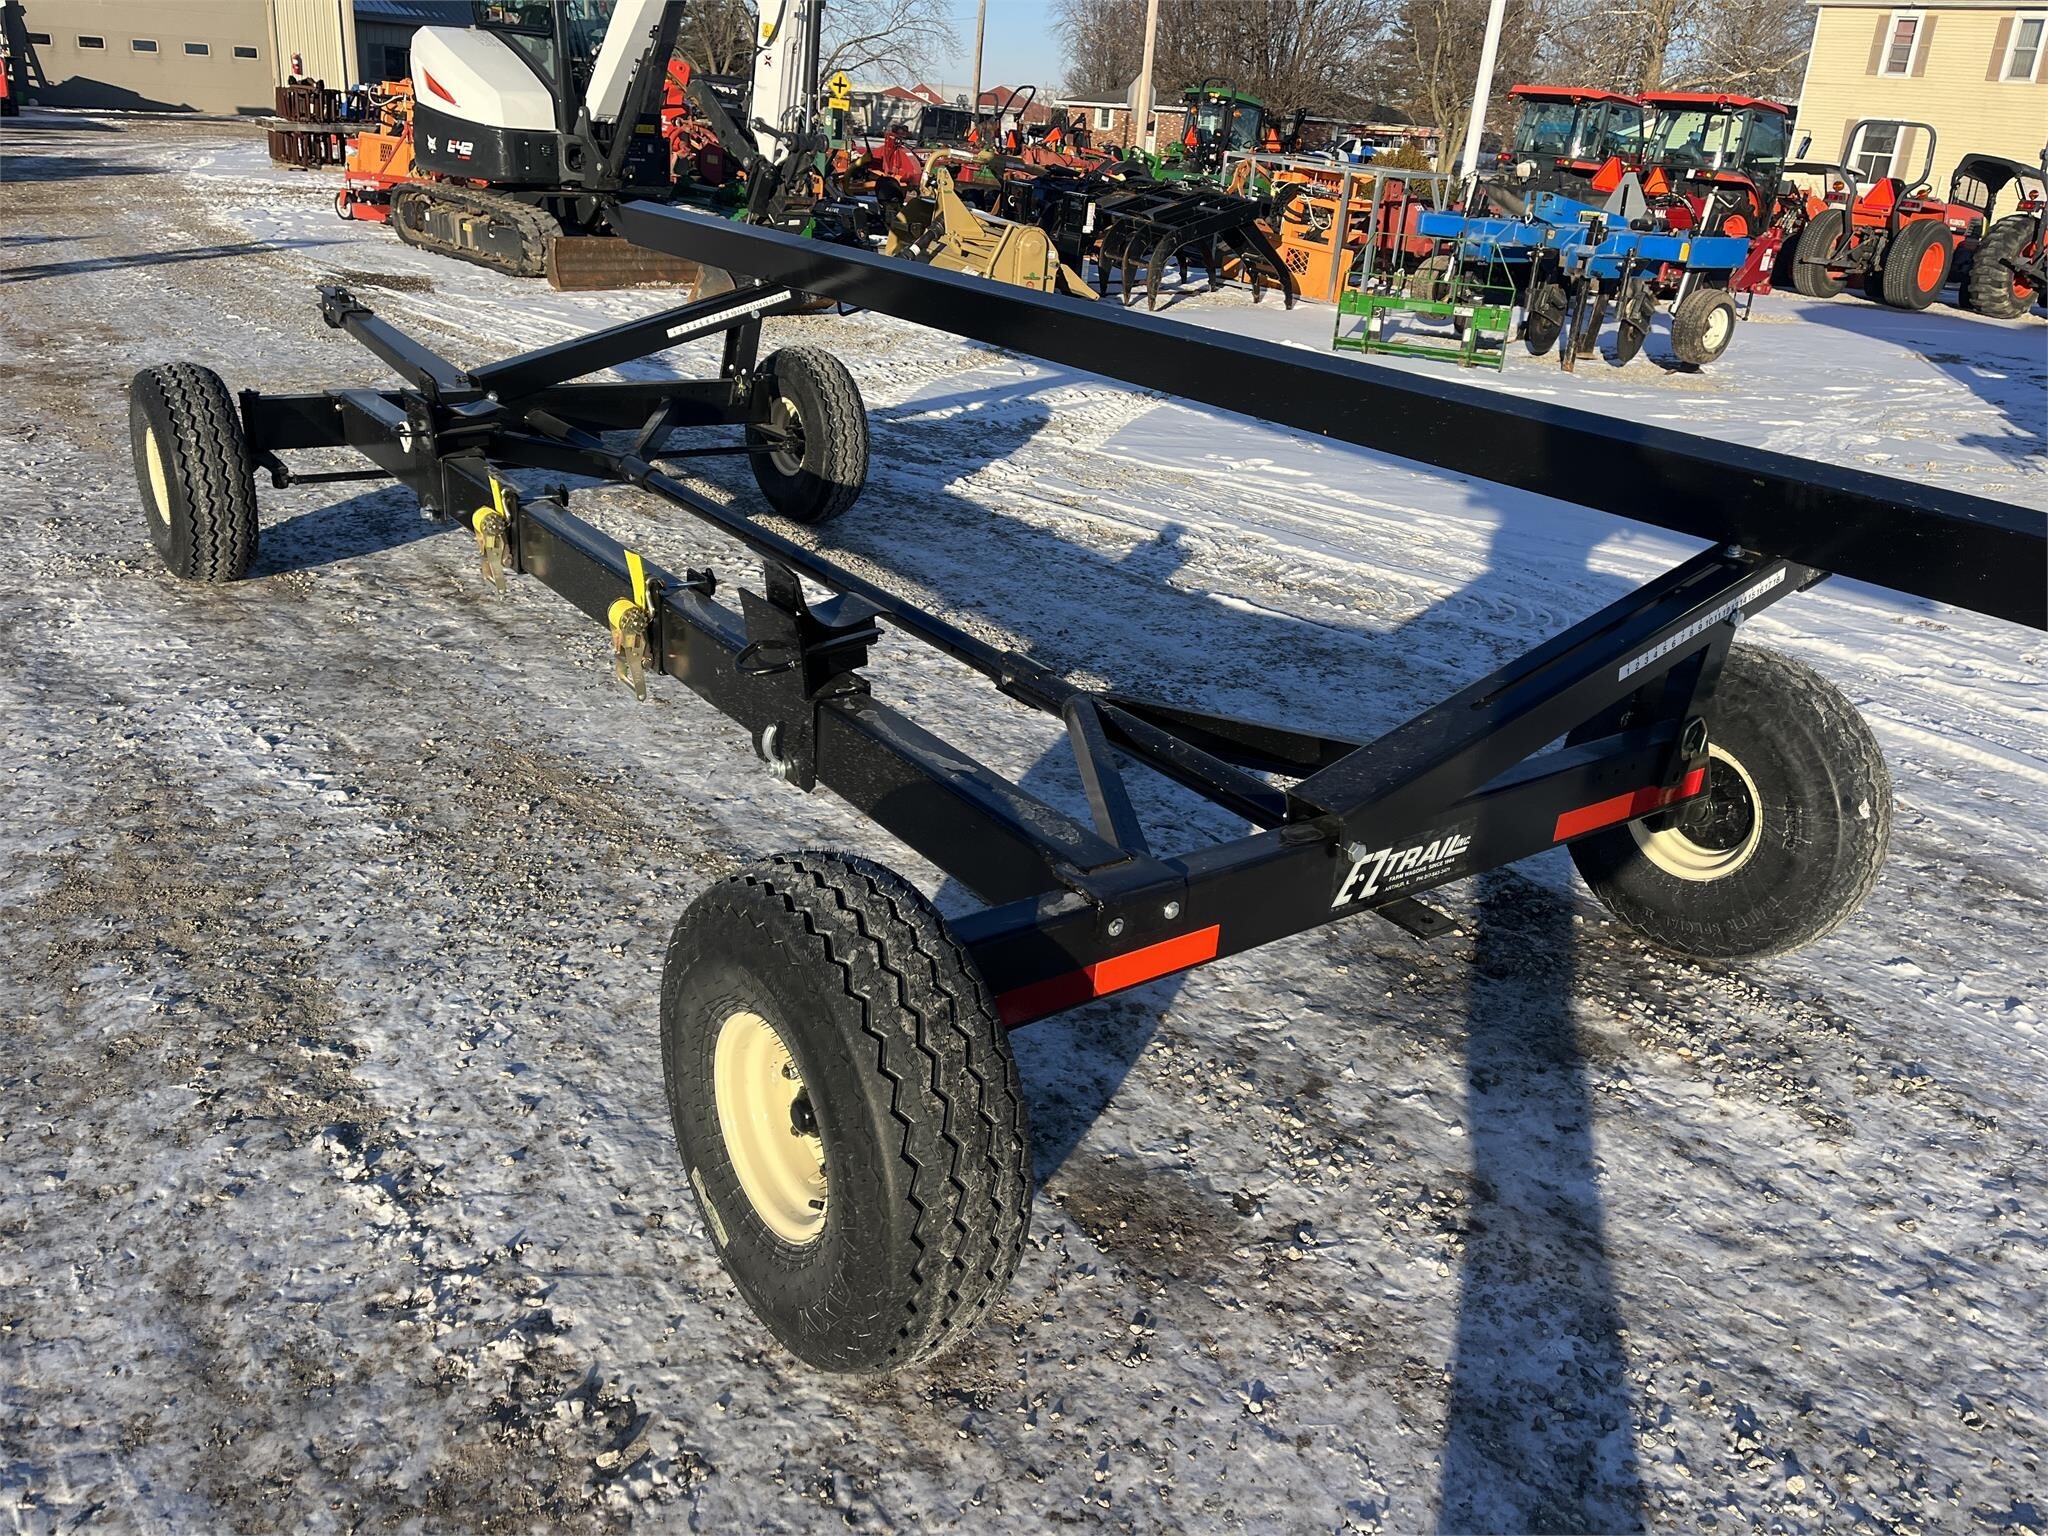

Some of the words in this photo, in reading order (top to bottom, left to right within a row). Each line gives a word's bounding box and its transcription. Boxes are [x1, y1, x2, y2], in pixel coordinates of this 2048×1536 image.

[447, 139, 474, 156] E42
[1383, 834, 1468, 877] TRAIL
[1389, 873, 1404, 882] FARM
[1405, 866, 1427, 877] WAGONS
[1428, 860, 1443, 870] SINCE
